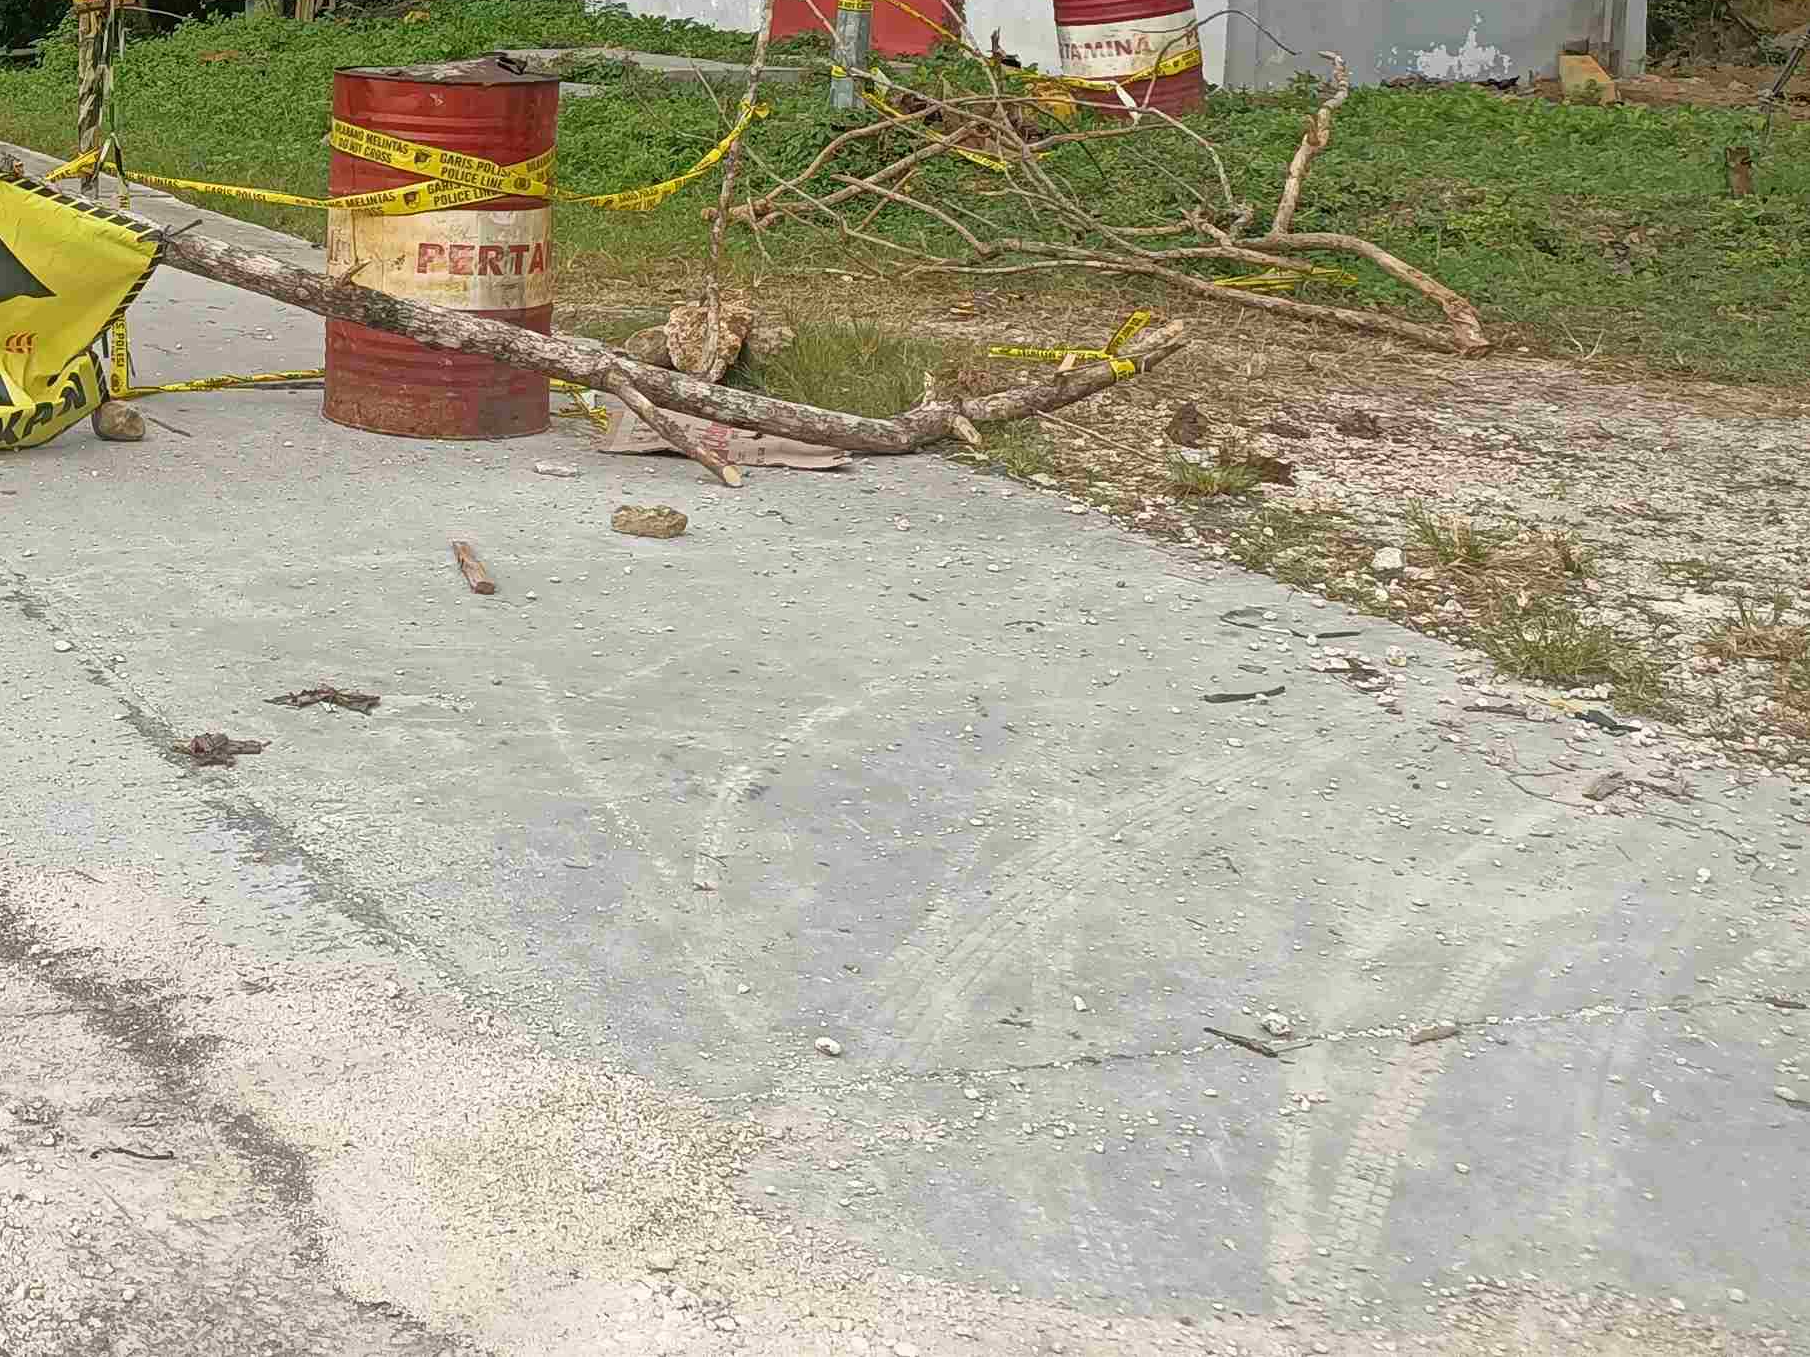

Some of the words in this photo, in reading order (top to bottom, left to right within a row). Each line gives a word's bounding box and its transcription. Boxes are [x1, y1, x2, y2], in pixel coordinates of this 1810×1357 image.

[365, 132, 409, 155] MELINTAS
[364, 145, 393, 164] CROSS
[440, 153, 473, 171] GARIS
[441, 167, 479, 184] POLICE
[480, 174, 504, 189] LINE
[345, 192, 396, 208] MELINTAS
[433, 190, 472, 205] POLICE
[417, 241, 545, 276] PERTA
